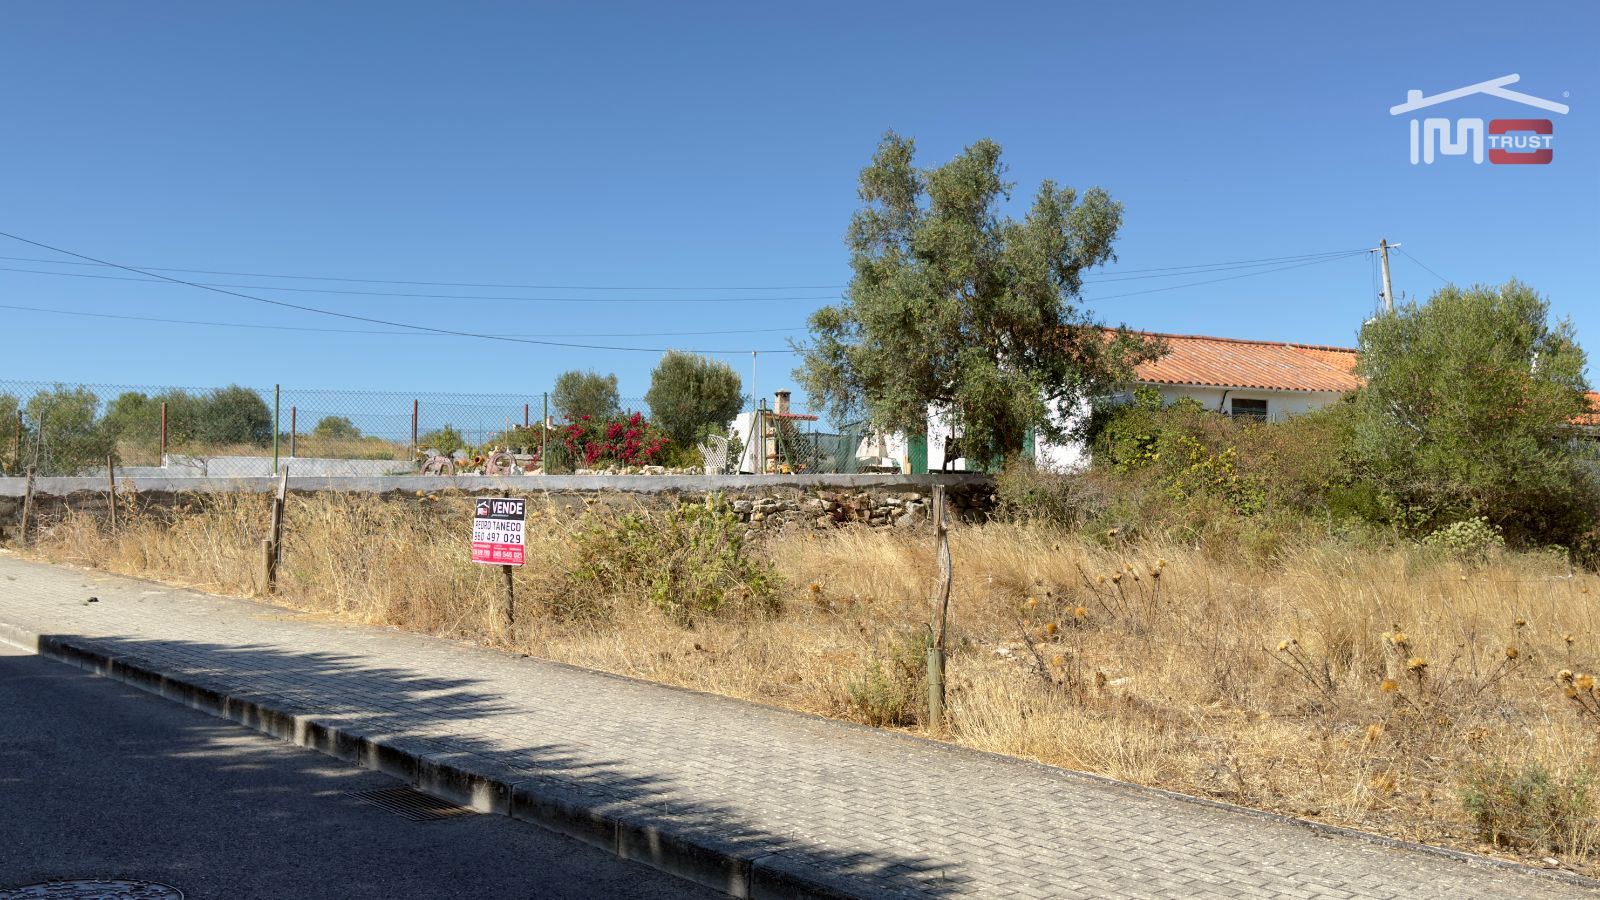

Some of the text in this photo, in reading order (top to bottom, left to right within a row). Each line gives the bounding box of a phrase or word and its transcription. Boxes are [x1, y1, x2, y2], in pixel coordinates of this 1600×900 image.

[492, 501, 523, 515] VENDE
[475, 520, 521, 532] PEDRO TANECO
[487, 532, 500, 542] 497
[504, 533, 521, 543] 029
